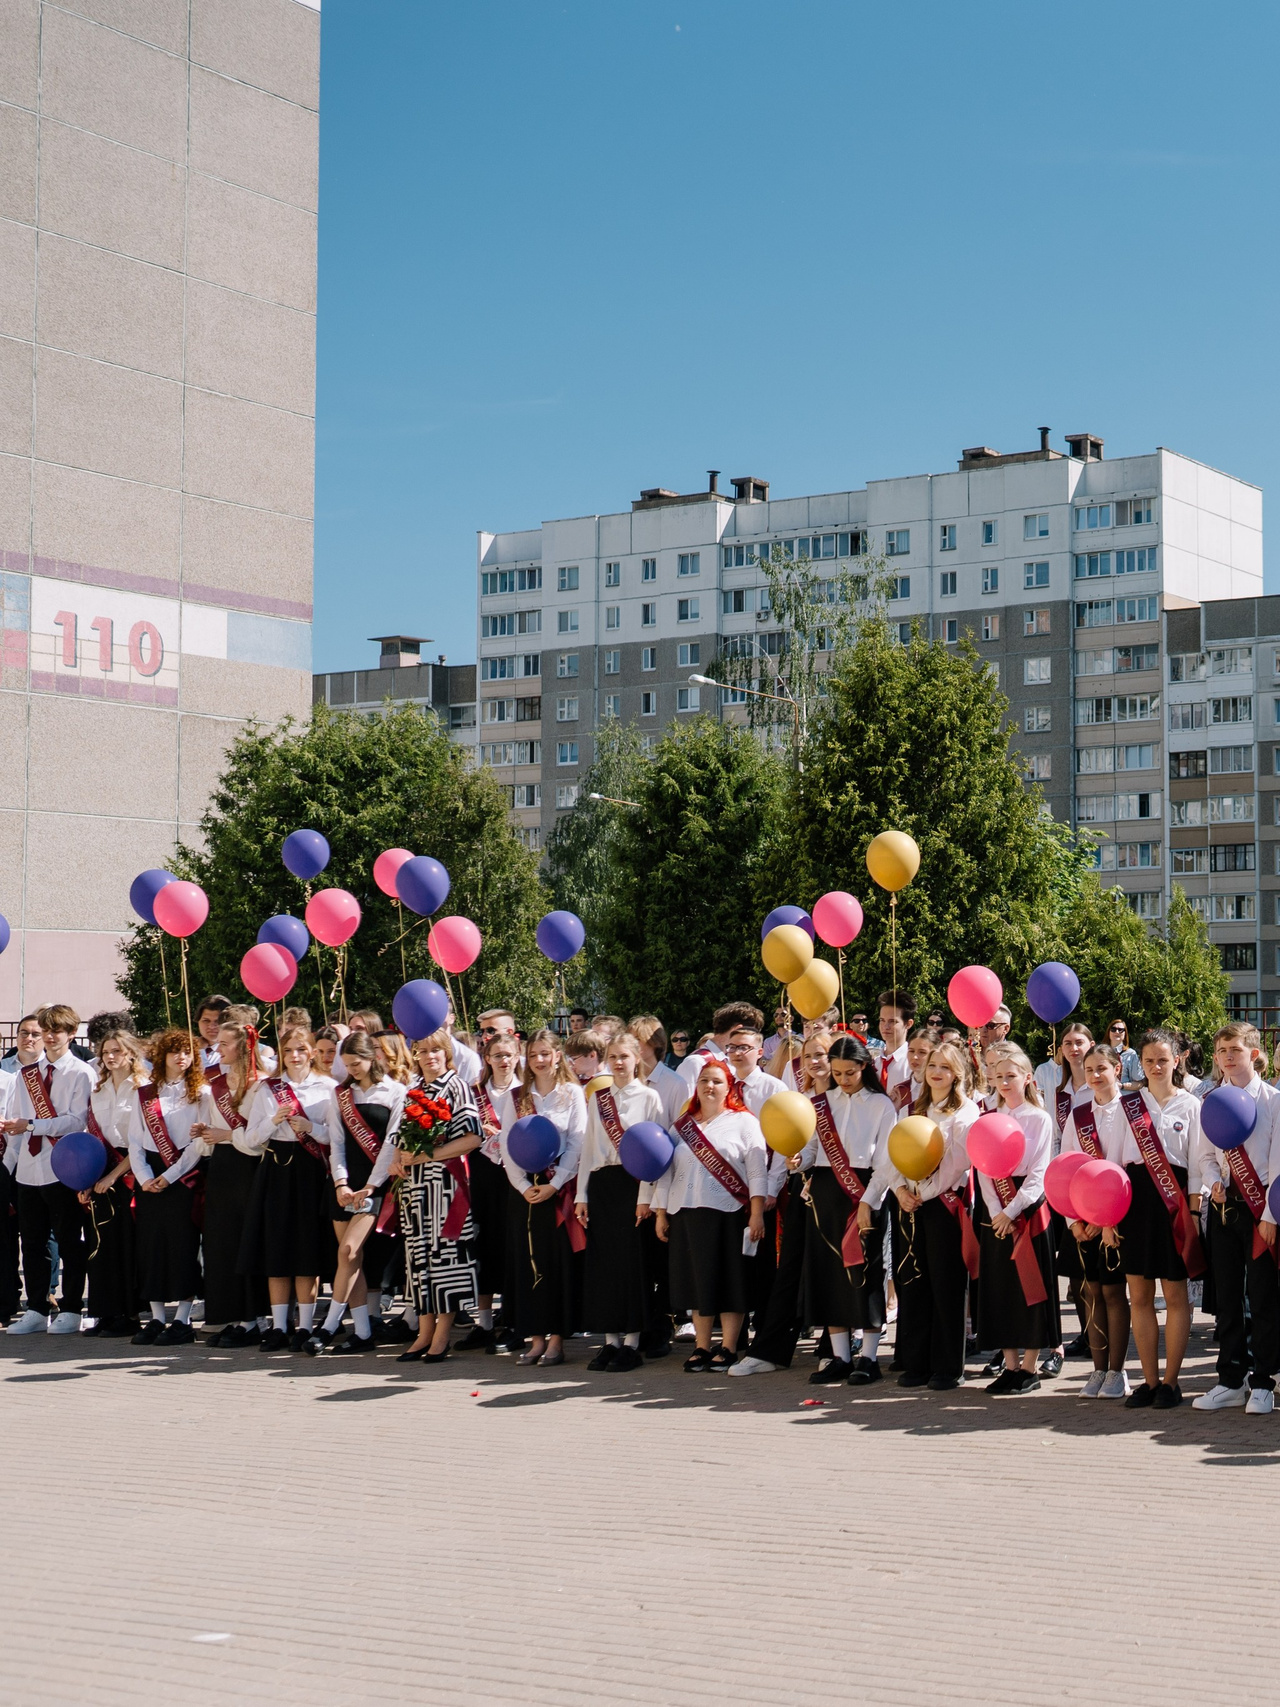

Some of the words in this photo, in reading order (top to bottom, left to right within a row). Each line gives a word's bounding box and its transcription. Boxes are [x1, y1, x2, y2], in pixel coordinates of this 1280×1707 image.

[53, 610, 163, 677] 110
[721, 1170, 743, 1193] 2024
[840, 1169, 860, 1195] 2024
[1156, 1169, 1177, 1198] 2024
[1243, 1178, 1264, 1206] 2024
